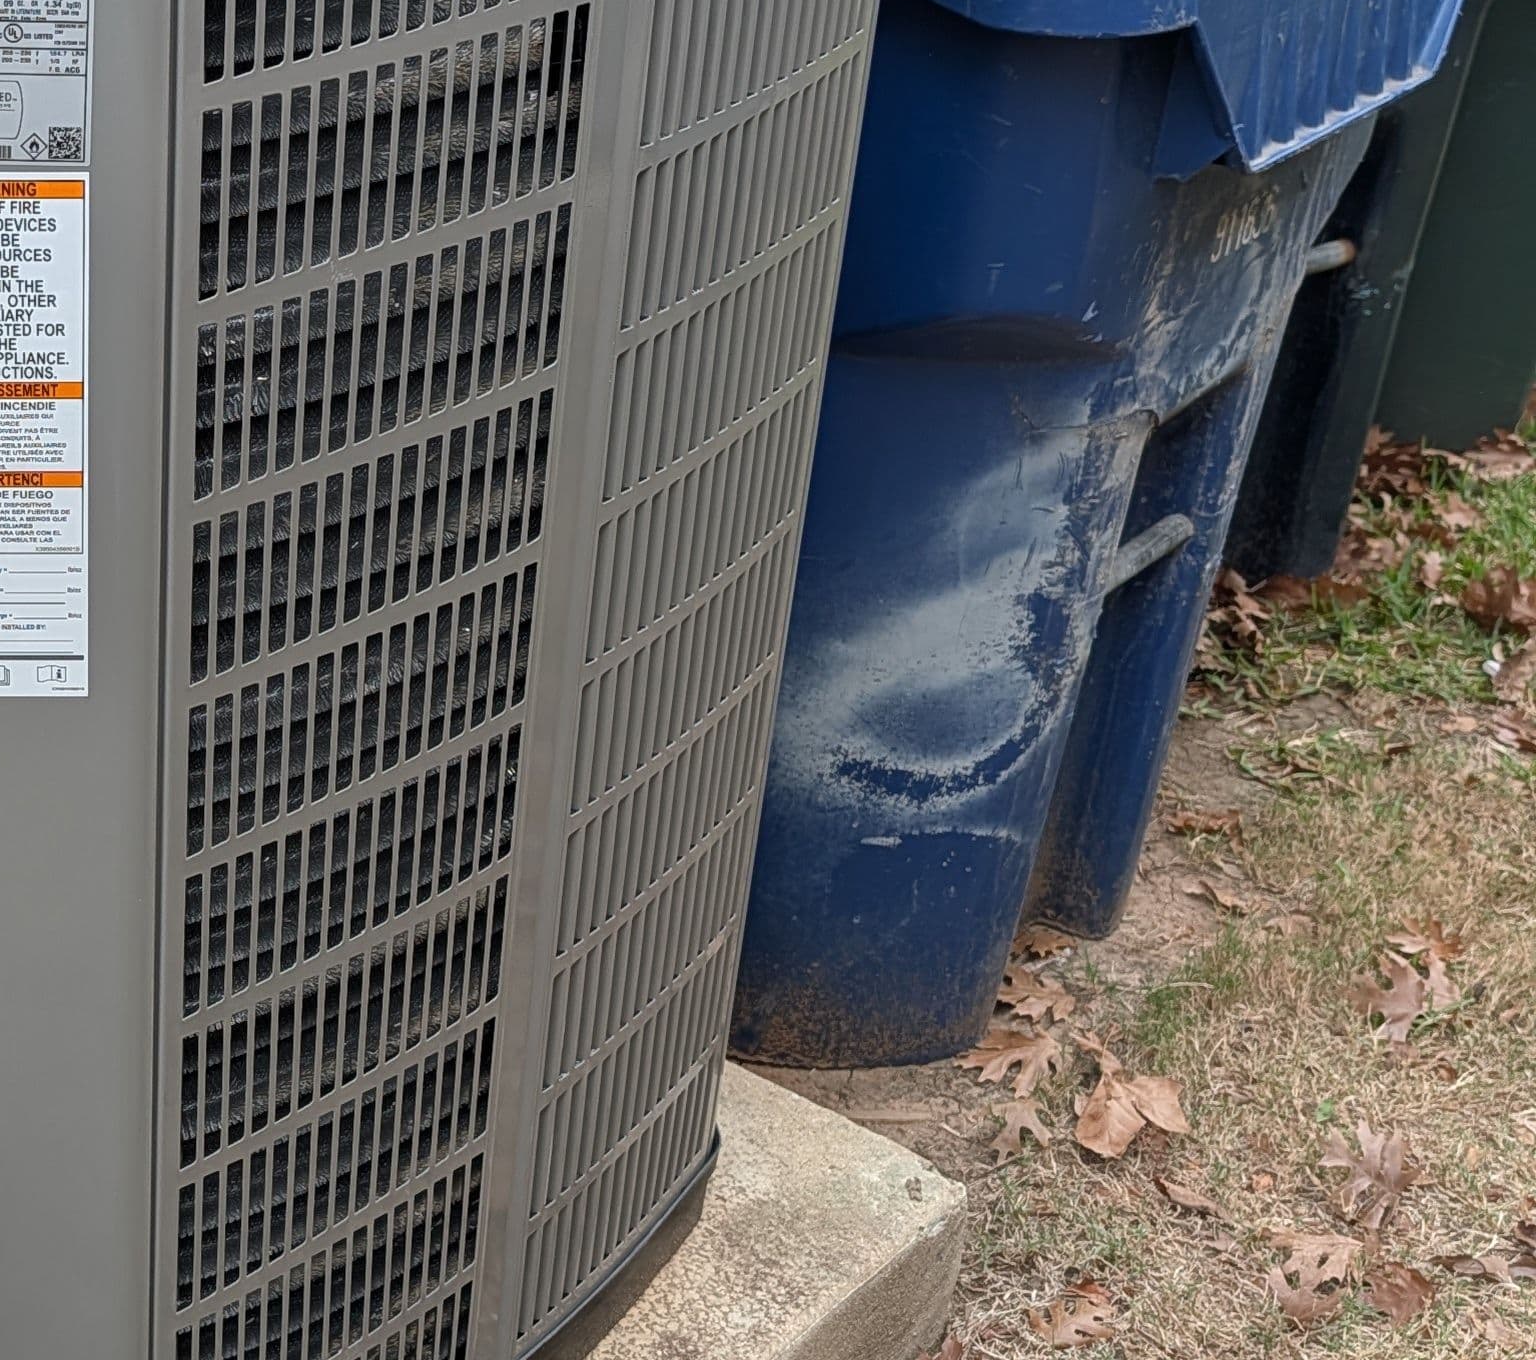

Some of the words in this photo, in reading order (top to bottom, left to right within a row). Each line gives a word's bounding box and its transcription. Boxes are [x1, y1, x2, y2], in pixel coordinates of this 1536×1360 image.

[10, 201, 41, 214] FIRE
[1, 234, 20, 247] BE
[0, 266, 19, 278] BE
[16, 280, 44, 293] THE
[8, 294, 57, 308] OTHER
[36, 324, 65, 337] FOR
[13, 491, 54, 499] FUEGO
